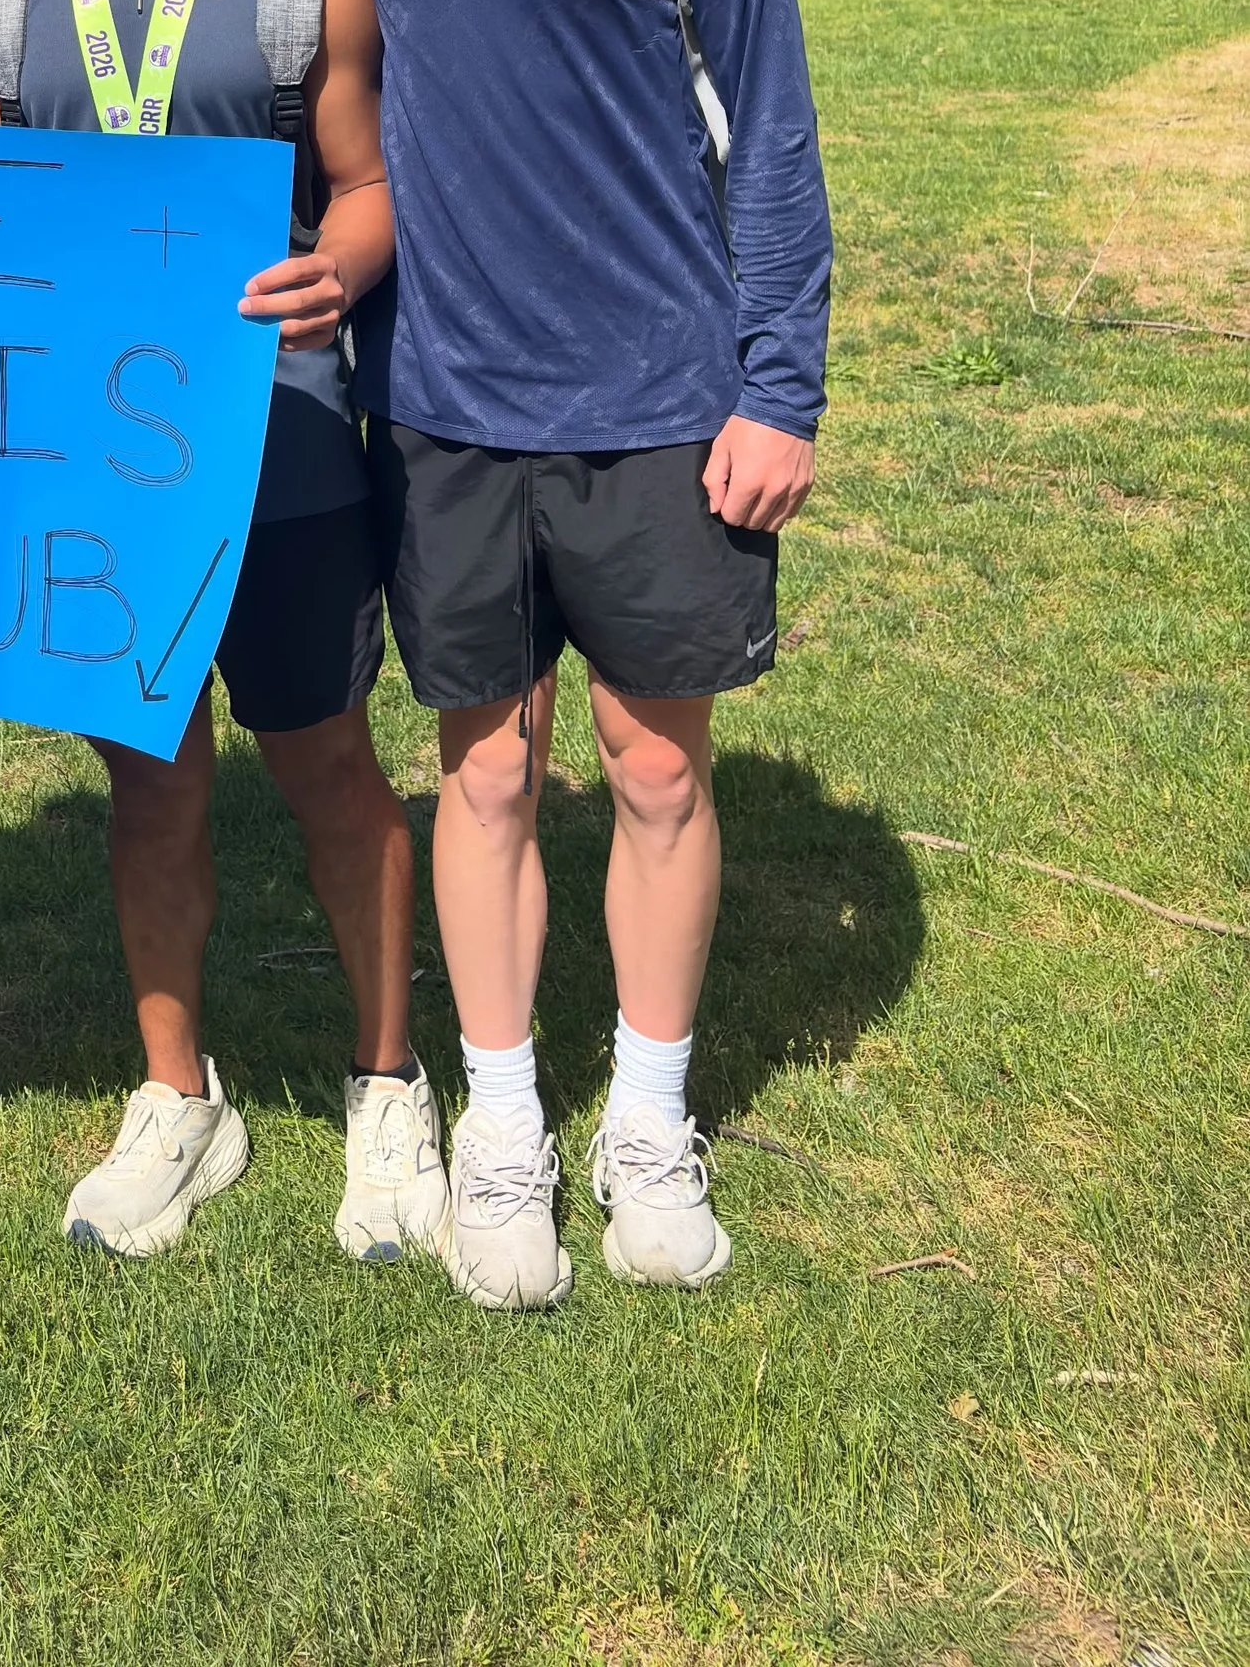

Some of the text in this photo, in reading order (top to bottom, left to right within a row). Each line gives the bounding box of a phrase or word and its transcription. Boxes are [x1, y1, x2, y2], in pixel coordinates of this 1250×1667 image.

[85, 30, 117, 78] 2026
[138, 97, 164, 135] CRR
[129, 205, 200, 268] +
